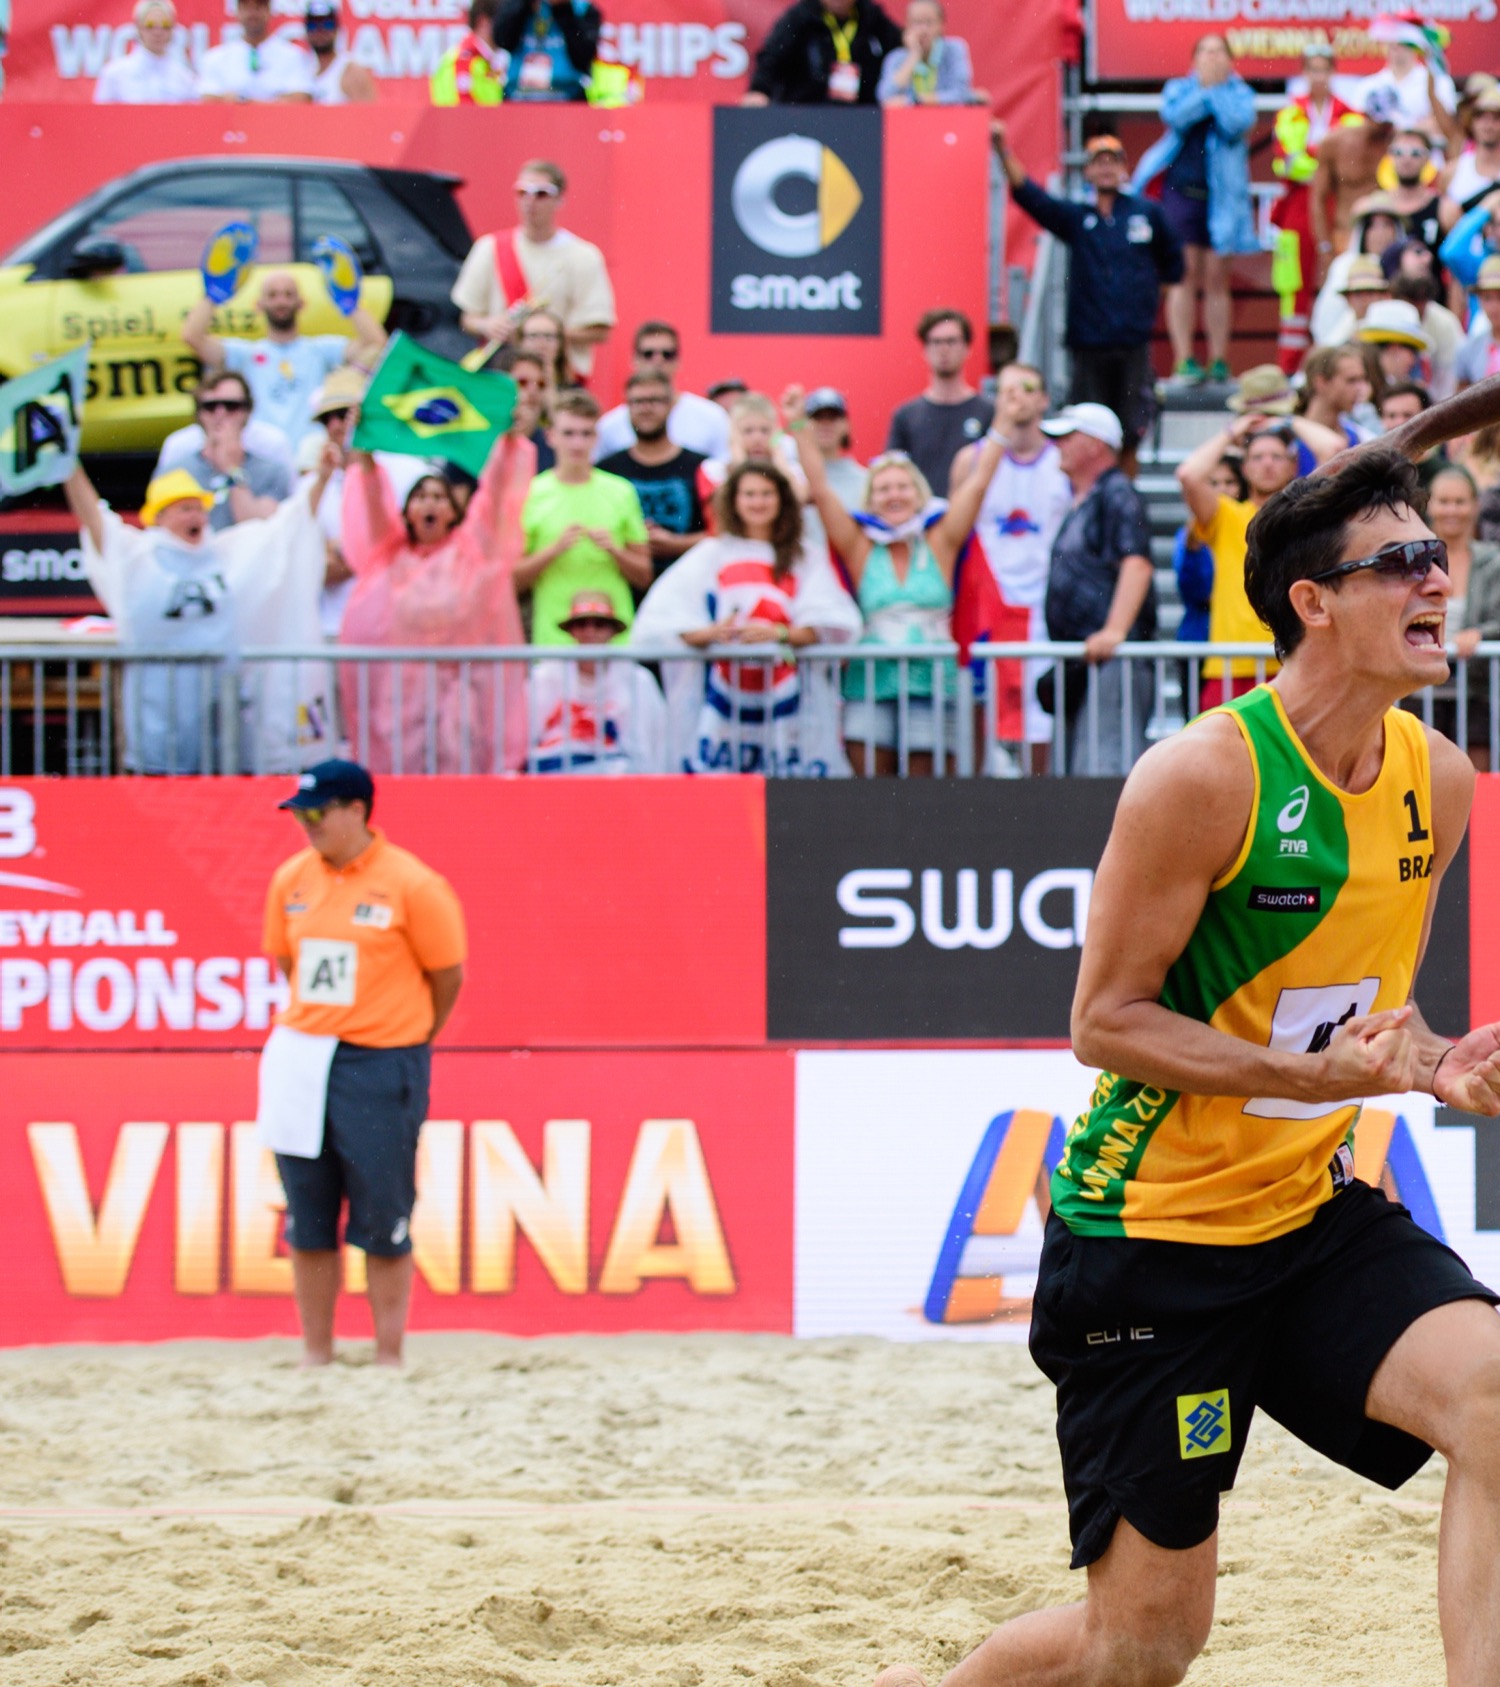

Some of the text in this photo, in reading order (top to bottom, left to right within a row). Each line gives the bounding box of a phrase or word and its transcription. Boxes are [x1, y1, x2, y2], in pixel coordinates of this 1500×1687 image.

[731, 271, 863, 311] smart
[62, 308, 259, 341] Spiel, atz
[84, 354, 203, 398] sma
[1403, 790, 1428, 843] 1
[1280, 839, 1308, 853] FIVB
[1257, 894, 1307, 905] swatch
[308, 952, 348, 991] A1
